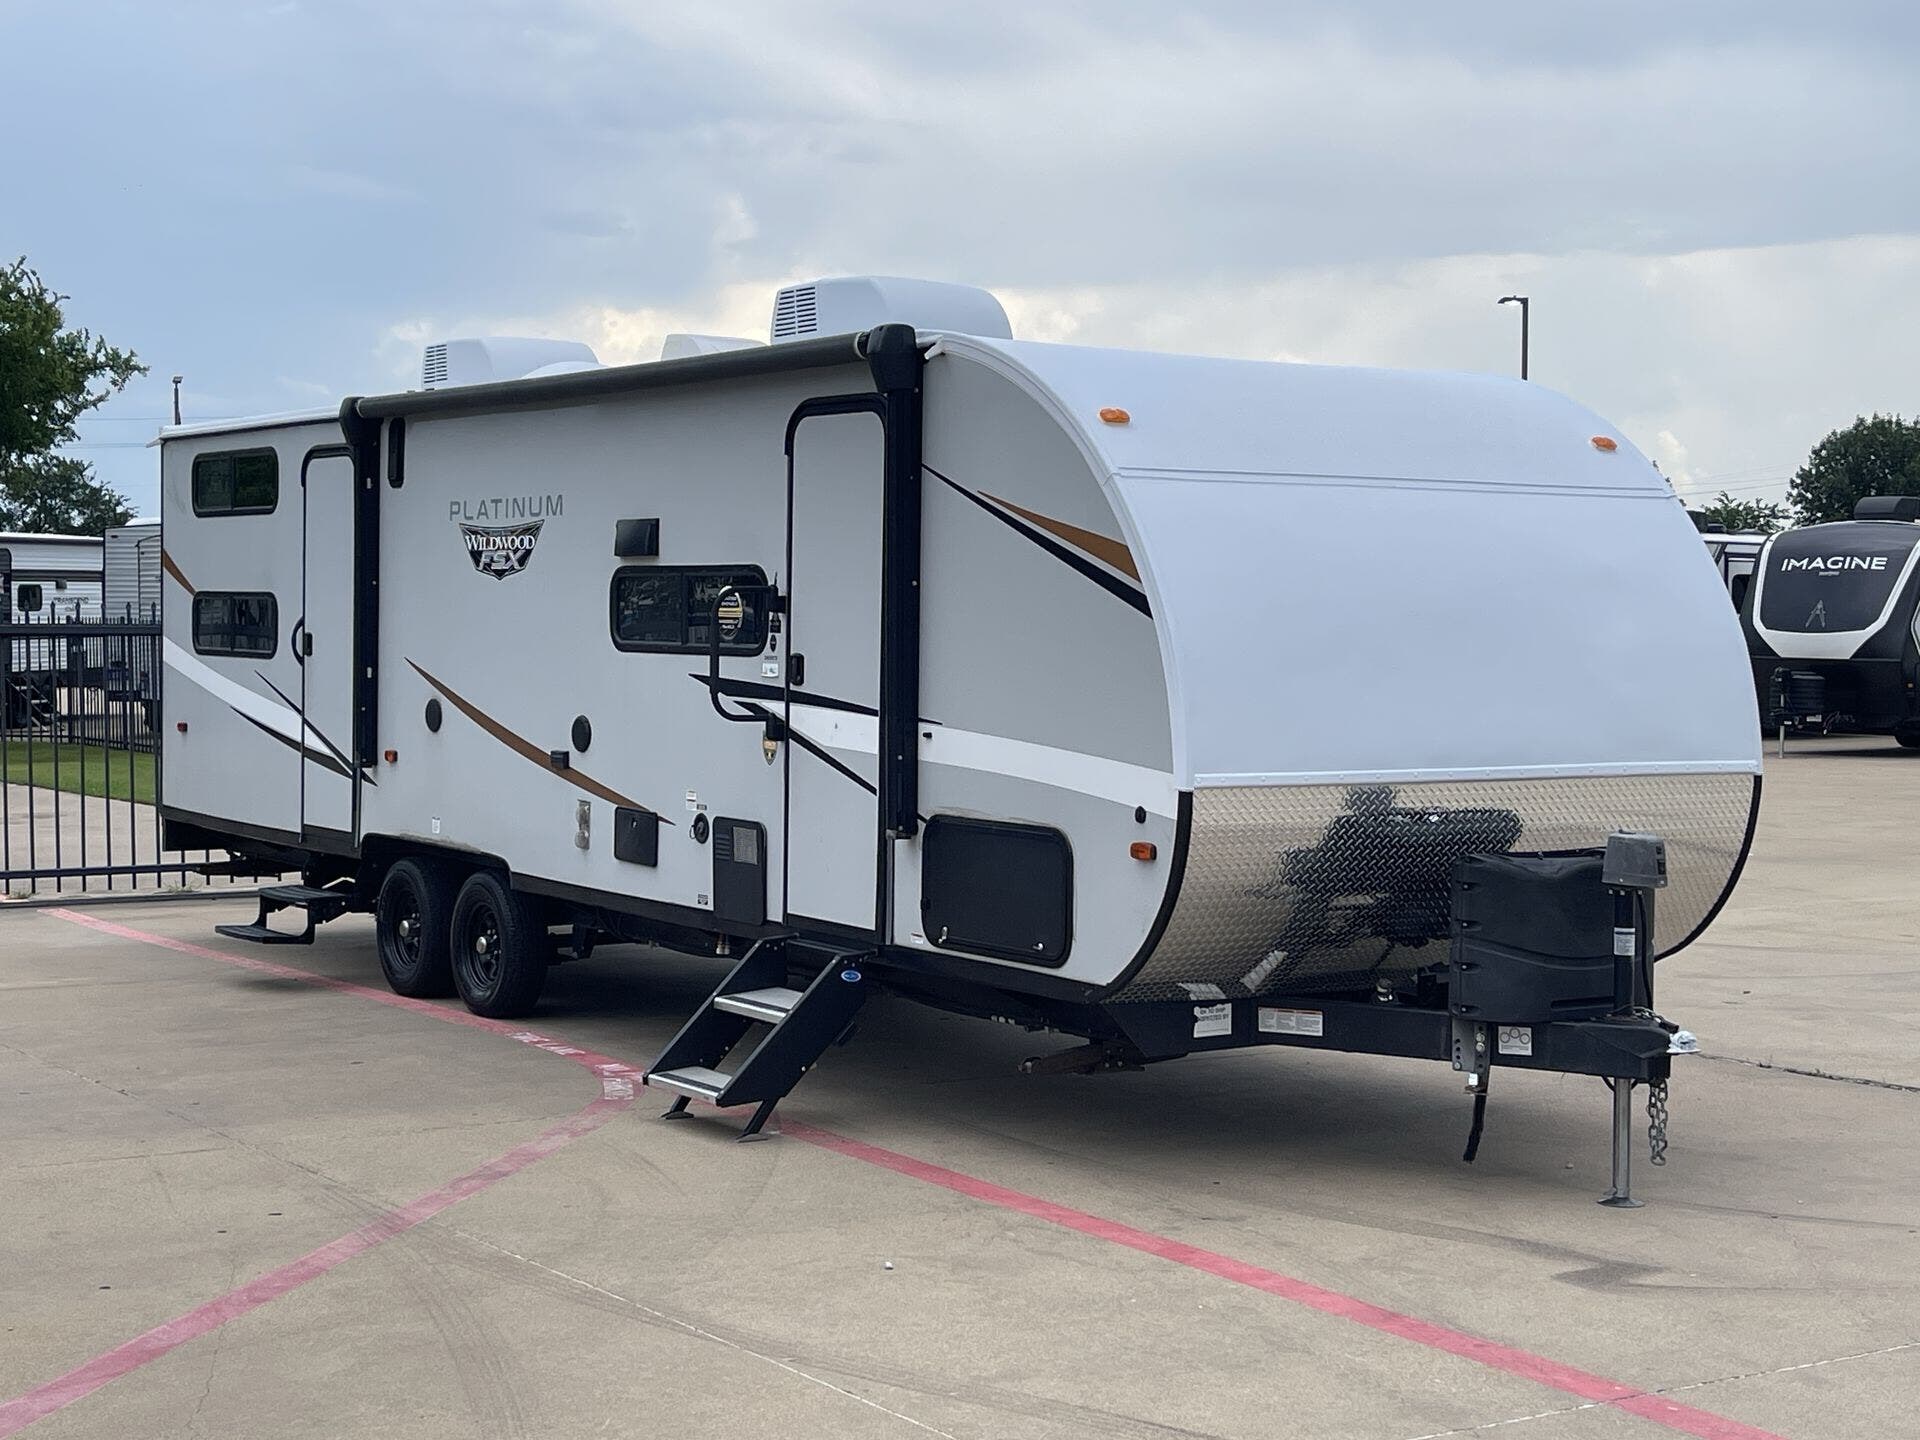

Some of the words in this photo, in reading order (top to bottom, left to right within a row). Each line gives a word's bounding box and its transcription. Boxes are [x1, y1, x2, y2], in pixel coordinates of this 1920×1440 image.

[449, 494, 564, 521] PLATINUM
[465, 535, 536, 550] WILDWOOD
[477, 550, 526, 570] FSX
[1781, 556, 1888, 571] IMAGINE
